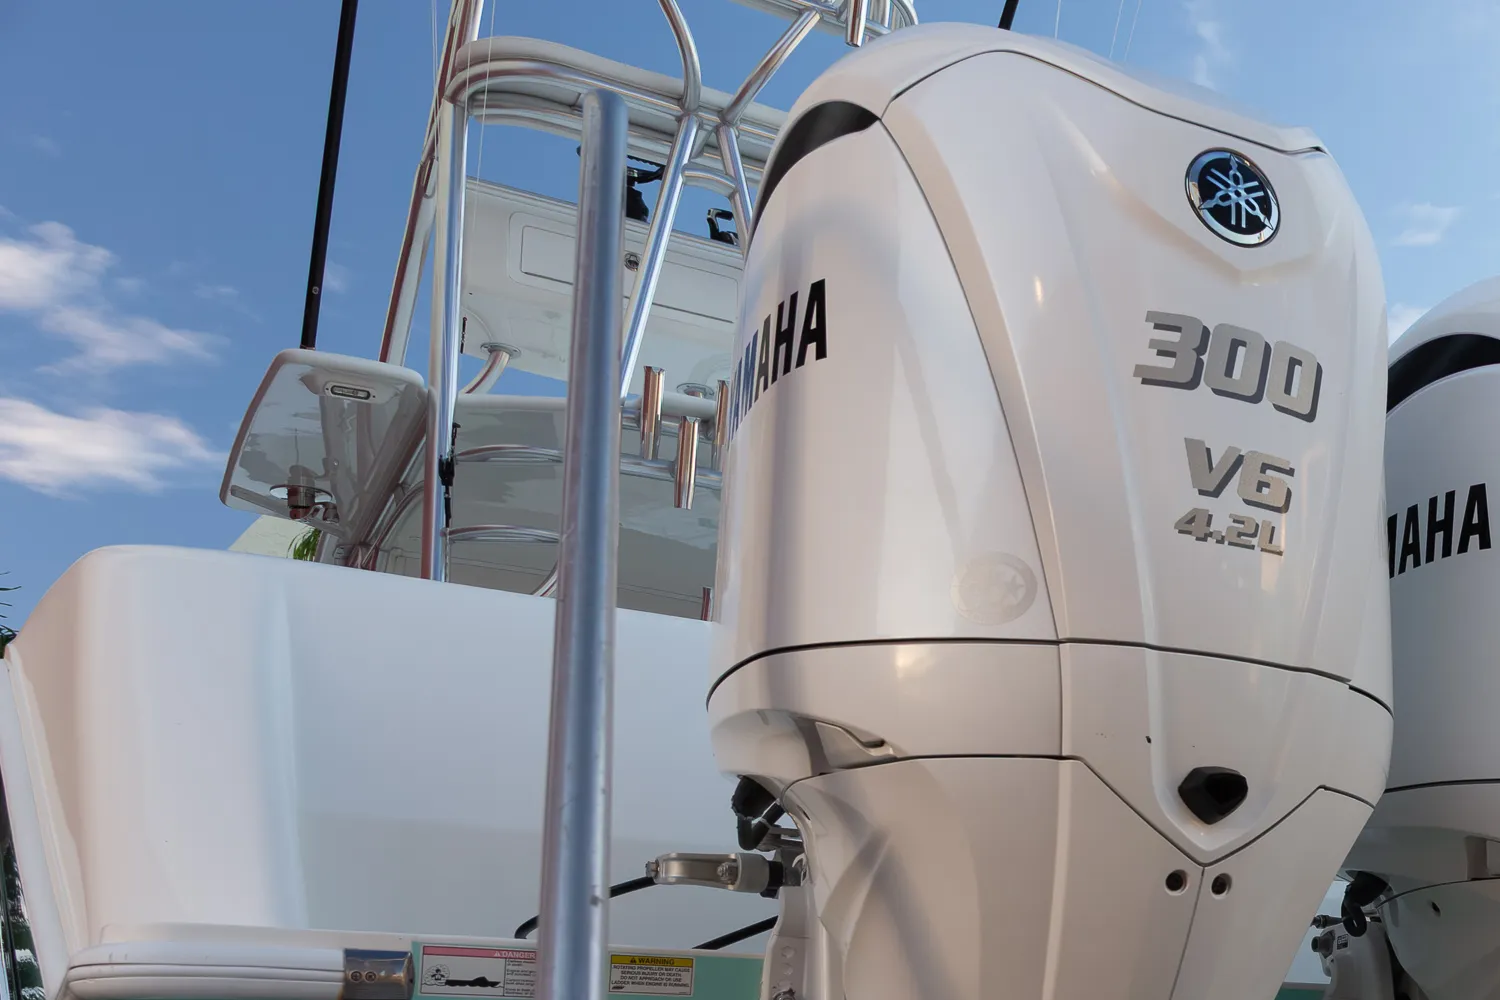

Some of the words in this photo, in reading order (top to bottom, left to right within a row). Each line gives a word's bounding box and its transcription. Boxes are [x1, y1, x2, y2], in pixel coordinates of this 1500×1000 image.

[1133, 310, 1323, 423] 300
[1184, 437, 1295, 514] V6
[1174, 508, 1284, 556] 4.2L
[502, 951, 536, 959] DANGER
[638, 957, 675, 965] WARNING
